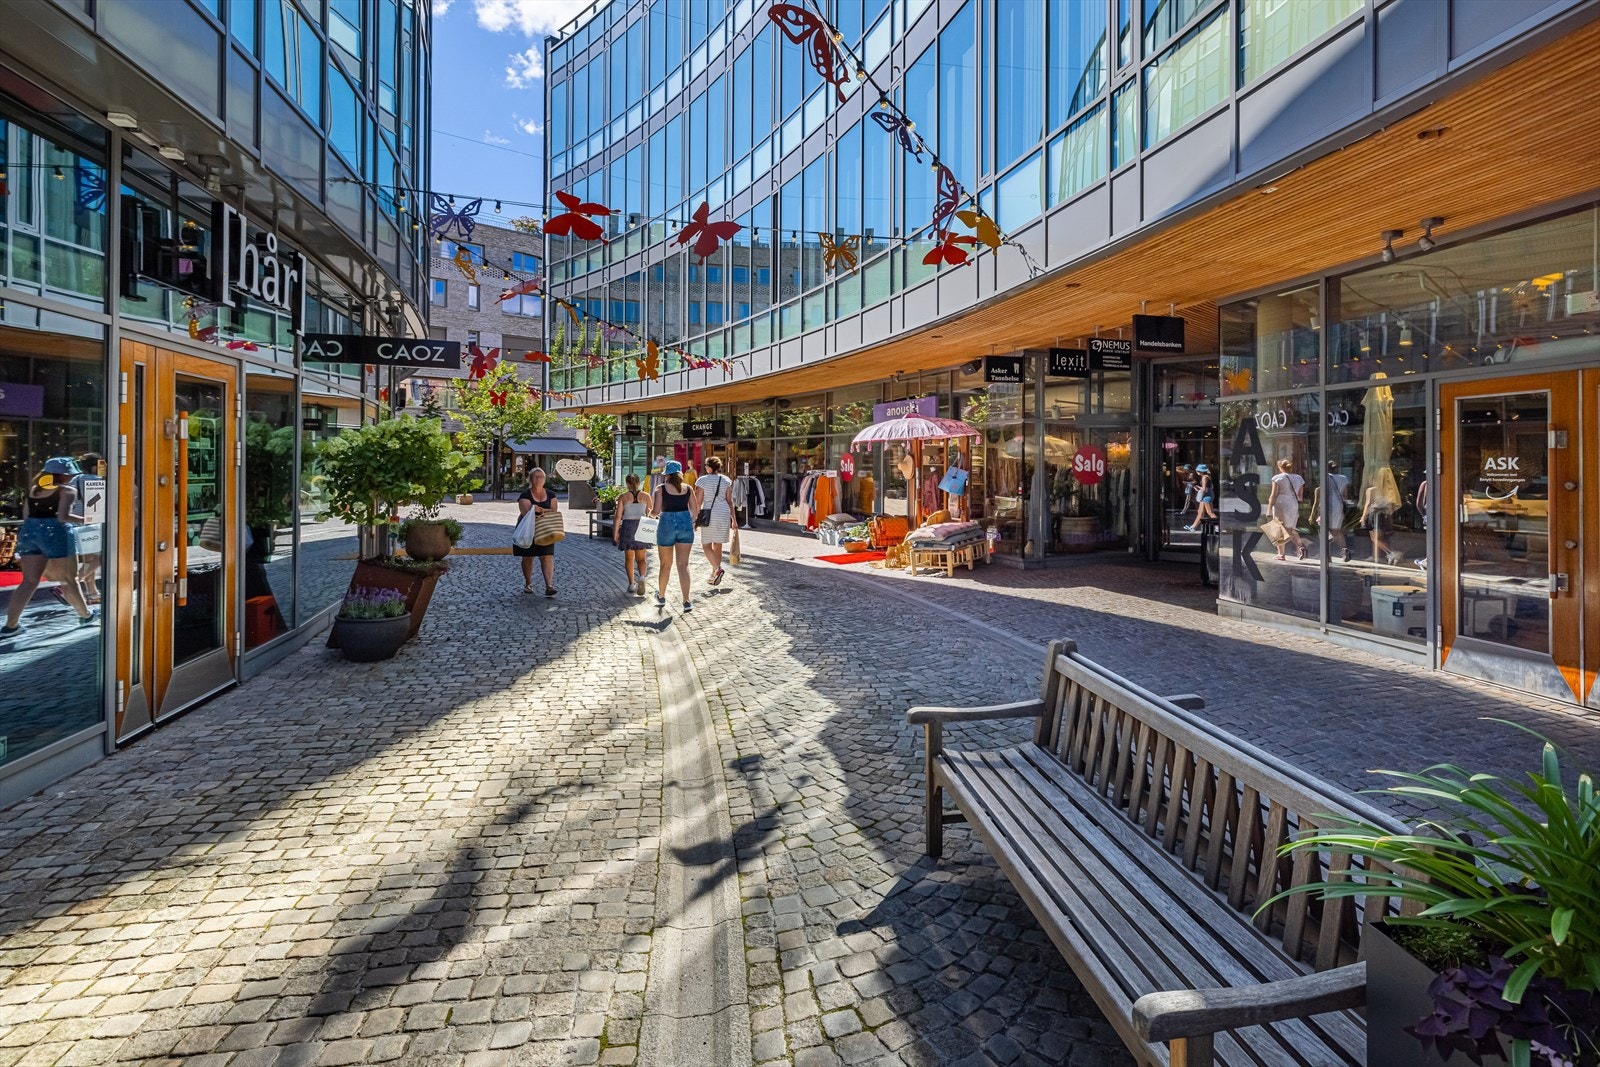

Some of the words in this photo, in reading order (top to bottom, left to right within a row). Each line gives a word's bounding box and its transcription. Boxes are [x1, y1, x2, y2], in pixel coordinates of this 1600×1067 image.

[1102, 340, 1131, 350] NEMUS
[1139, 340, 1182, 348] Handelsbanken
[377, 343, 445, 362] CAOZ
[1055, 353, 1084, 368] lexit
[990, 374, 1020, 382] Tannhelse
[691, 422, 713, 431] CHANGE
[840, 458, 853, 476] Salg
[1074, 453, 1104, 477] Salg
[1484, 456, 1520, 470] ASK
